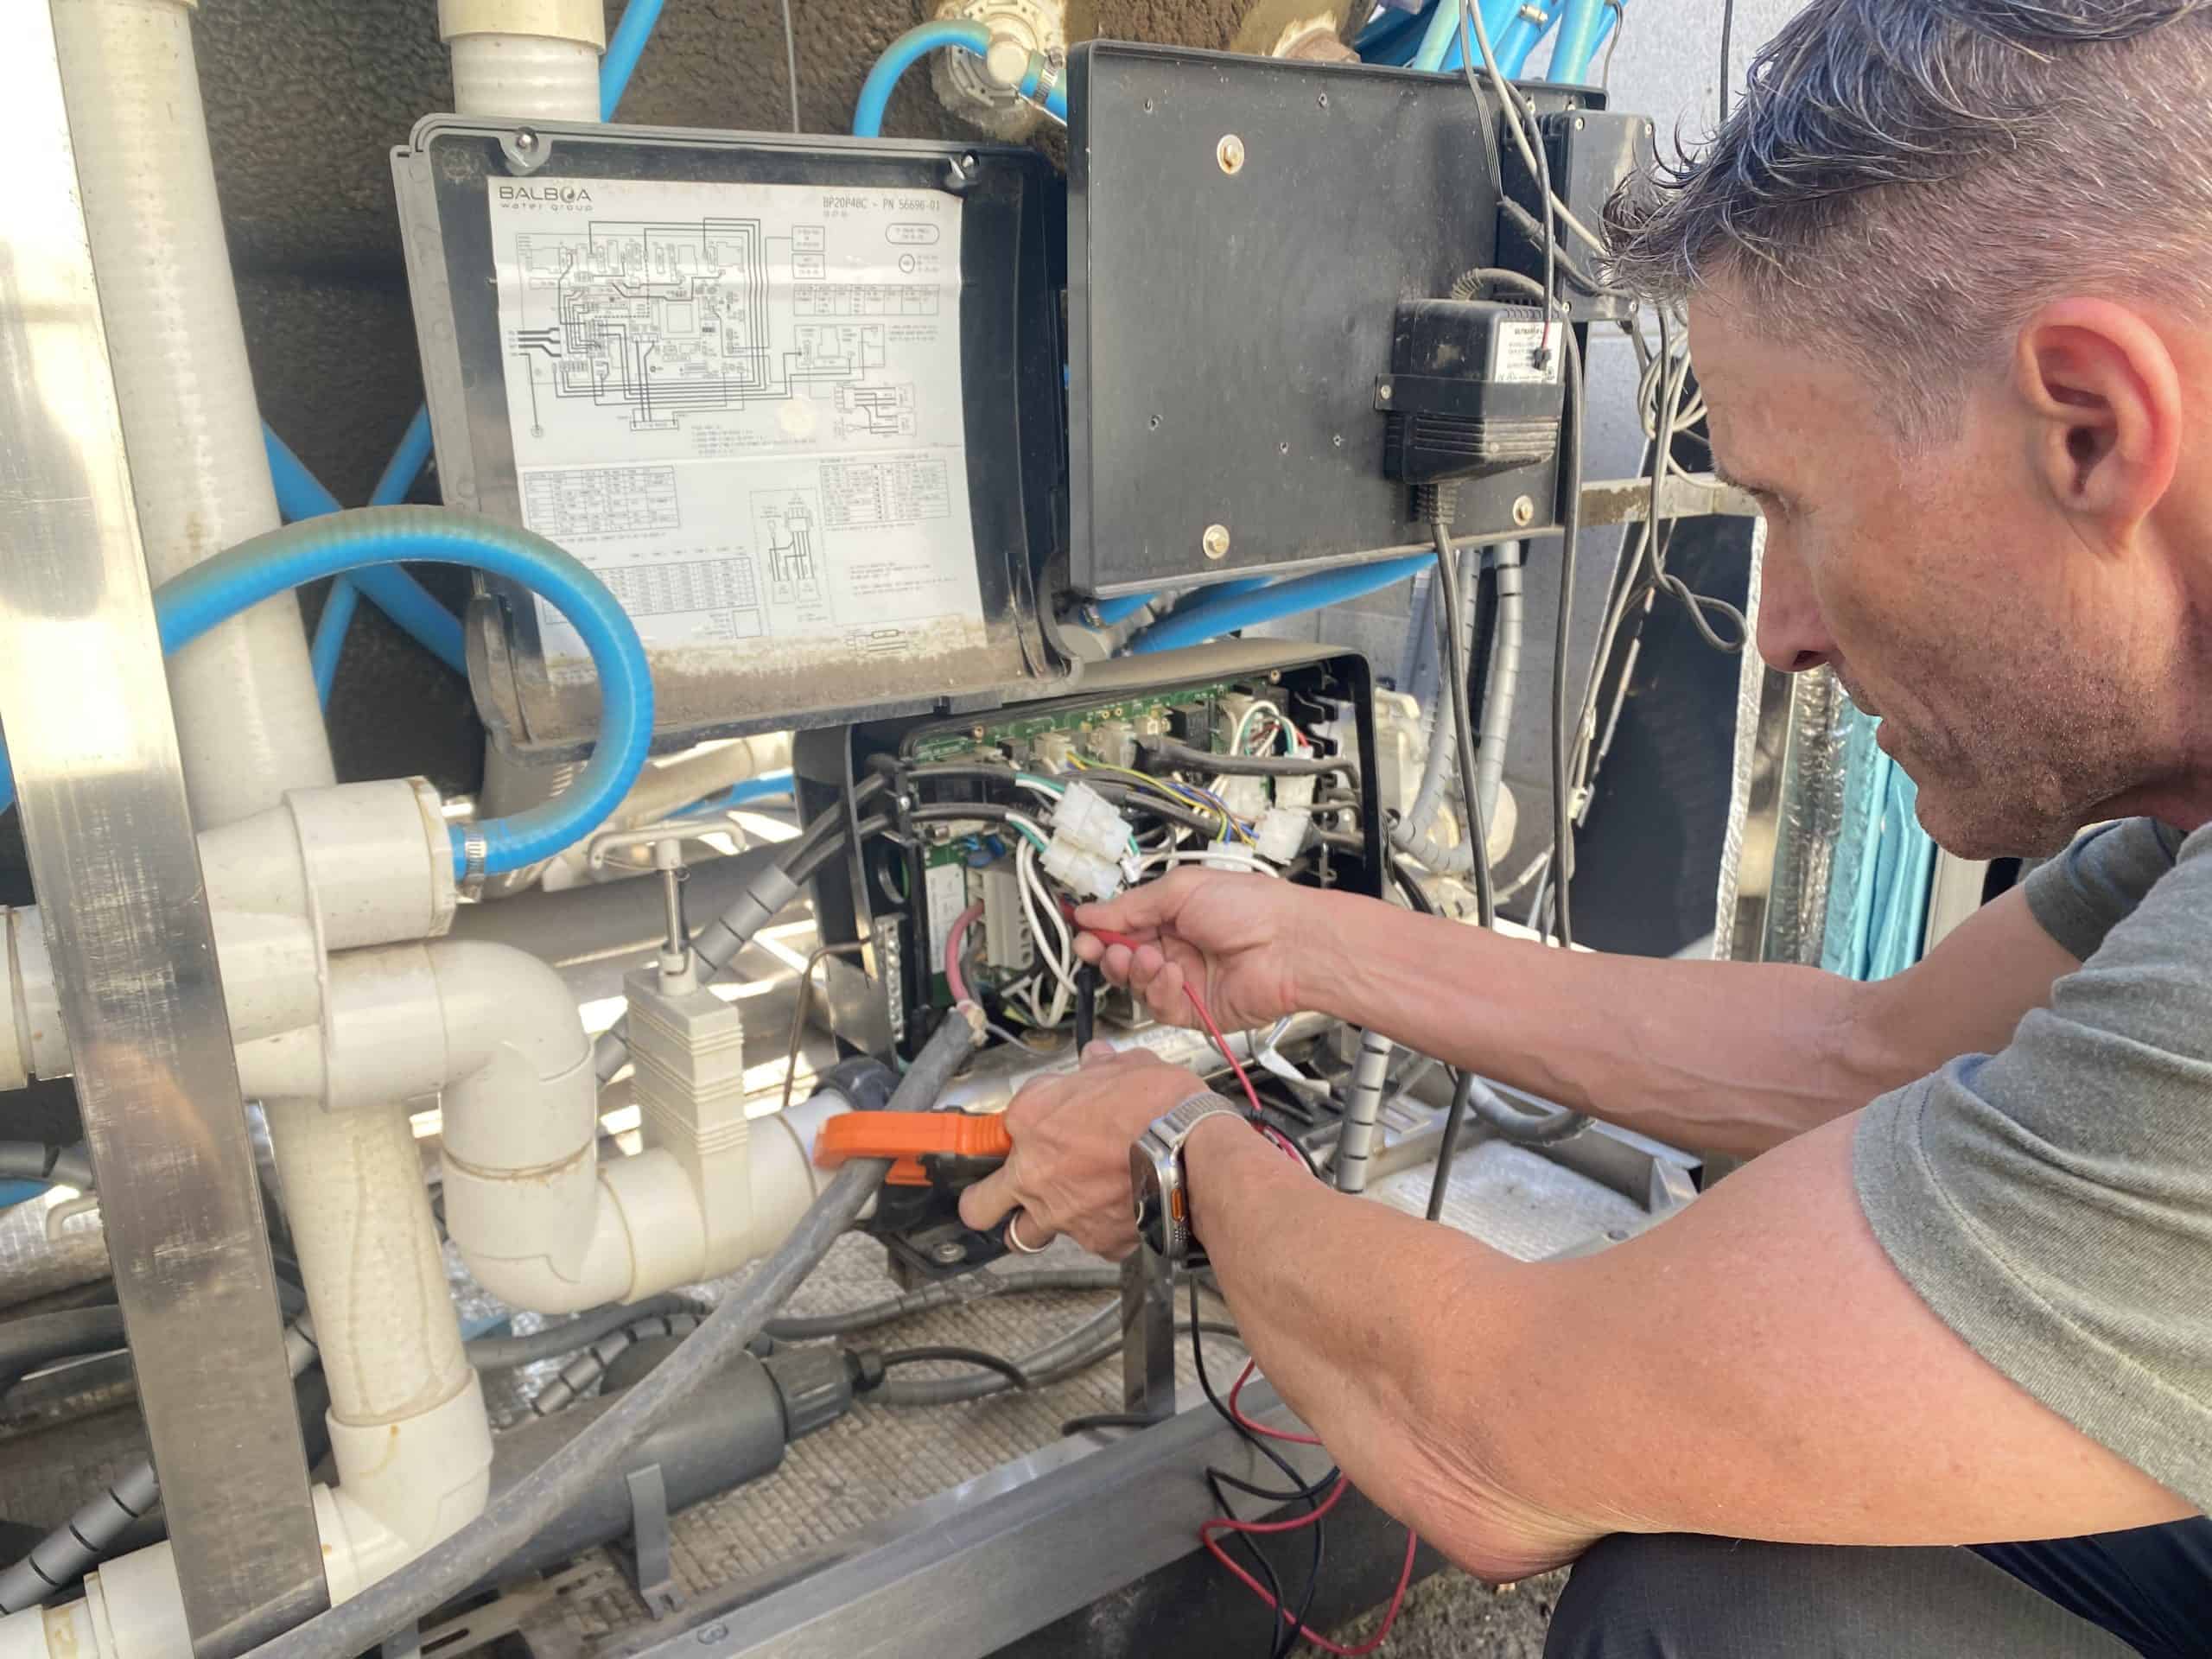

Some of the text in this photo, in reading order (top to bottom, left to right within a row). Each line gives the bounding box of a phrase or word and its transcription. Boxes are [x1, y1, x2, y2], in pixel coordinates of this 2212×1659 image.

[499, 186, 592, 203] BALBOA
[551, 203, 594, 213] group
[883, 199, 894, 209] PN
